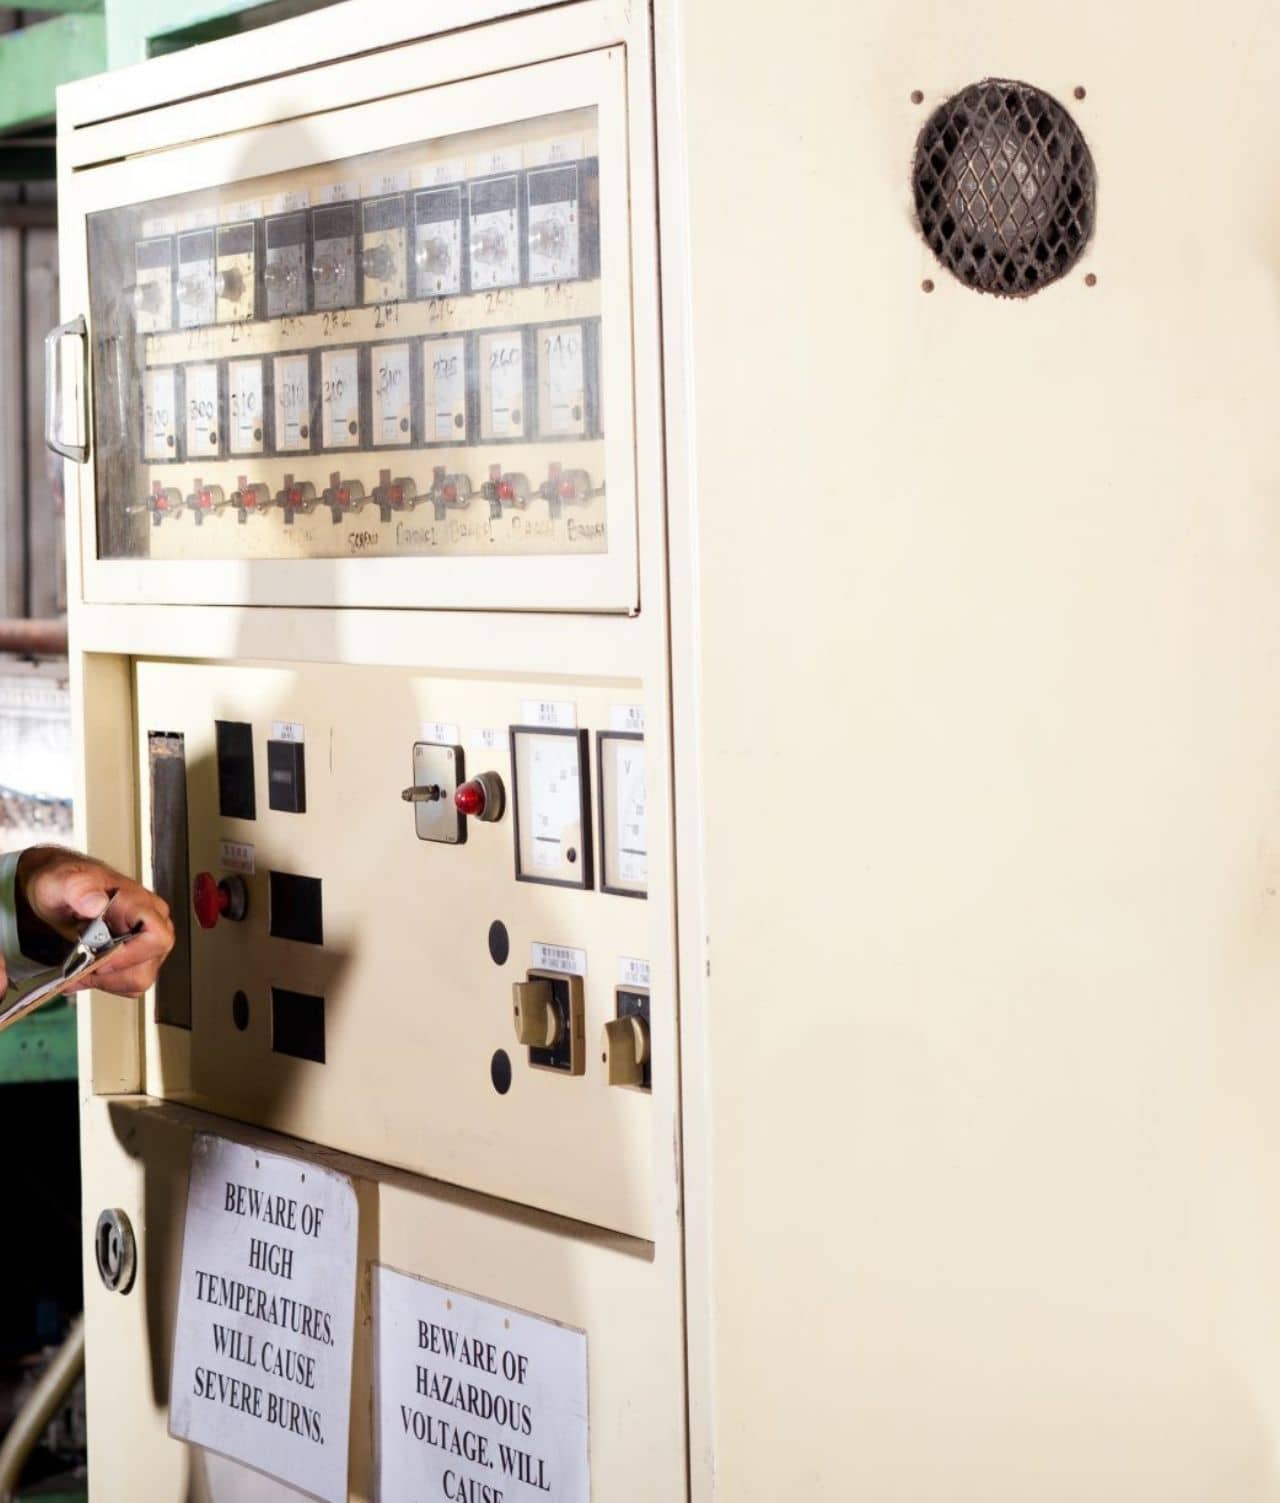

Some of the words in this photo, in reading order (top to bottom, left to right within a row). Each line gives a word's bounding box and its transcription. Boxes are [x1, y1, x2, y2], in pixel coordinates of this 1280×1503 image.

[224, 1182, 298, 1231] BEWARE
[301, 1204, 325, 1238] OF
[248, 1238, 294, 1280] HIGH
[195, 1270, 334, 1347] TEMPERATURES.
[212, 1323, 257, 1367] WILL
[261, 1341, 316, 1390] CAUSE
[418, 1319, 497, 1375] BEWARE
[502, 1350, 529, 1385] OF
[193, 1366, 263, 1418] SEVERE
[267, 1392, 325, 1446] BURNS.
[416, 1364, 532, 1436] HAZARDOUS
[400, 1404, 494, 1469] VOLTAGE.
[497, 1443, 551, 1492] WILL
